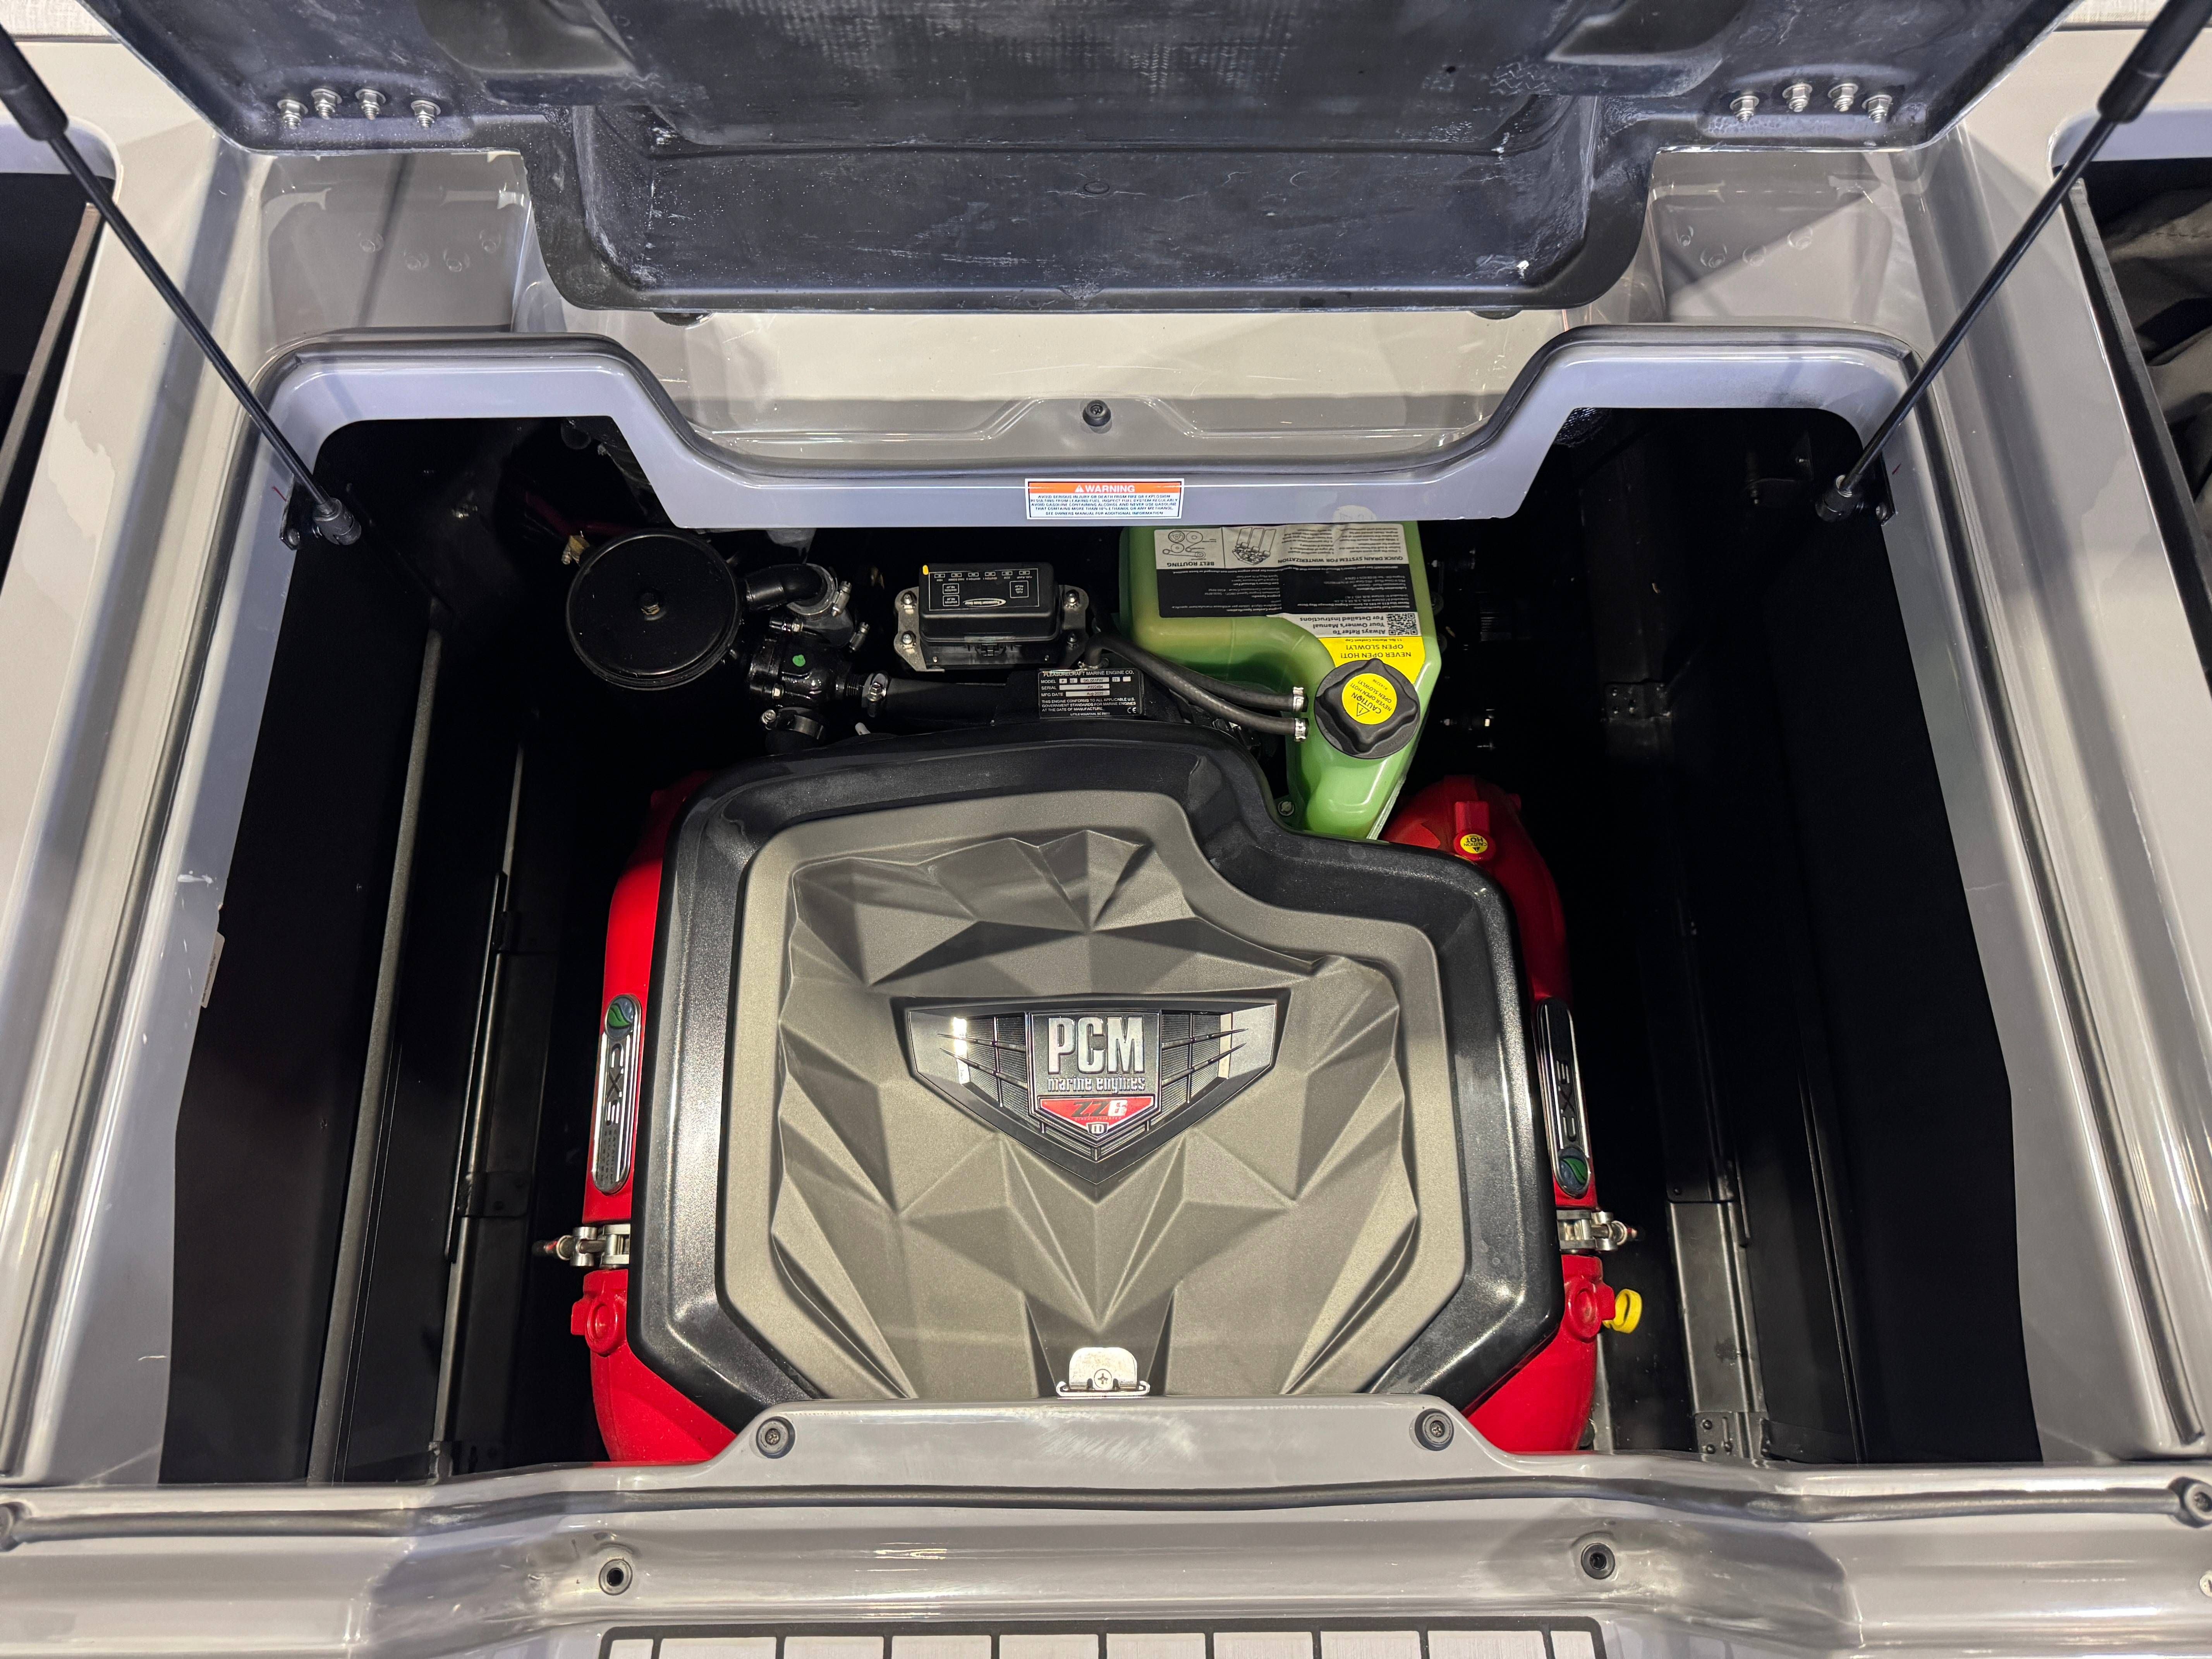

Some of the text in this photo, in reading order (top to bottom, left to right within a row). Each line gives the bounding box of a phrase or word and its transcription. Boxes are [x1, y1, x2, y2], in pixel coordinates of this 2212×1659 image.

[1350, 683, 1392, 711] NEVER OPEN HOT!
[1351, 692, 1381, 714] CAUTION
[1358, 680, 1392, 703] OPEN SLOWLY!
[1048, 1016, 1145, 1074] PCM
[605, 1042, 624, 1126] CXS
[1048, 1074, 1146, 1094] marine engines
[1071, 1099, 1128, 1117] ZZ6
[1556, 1060, 1577, 1142] CXS
